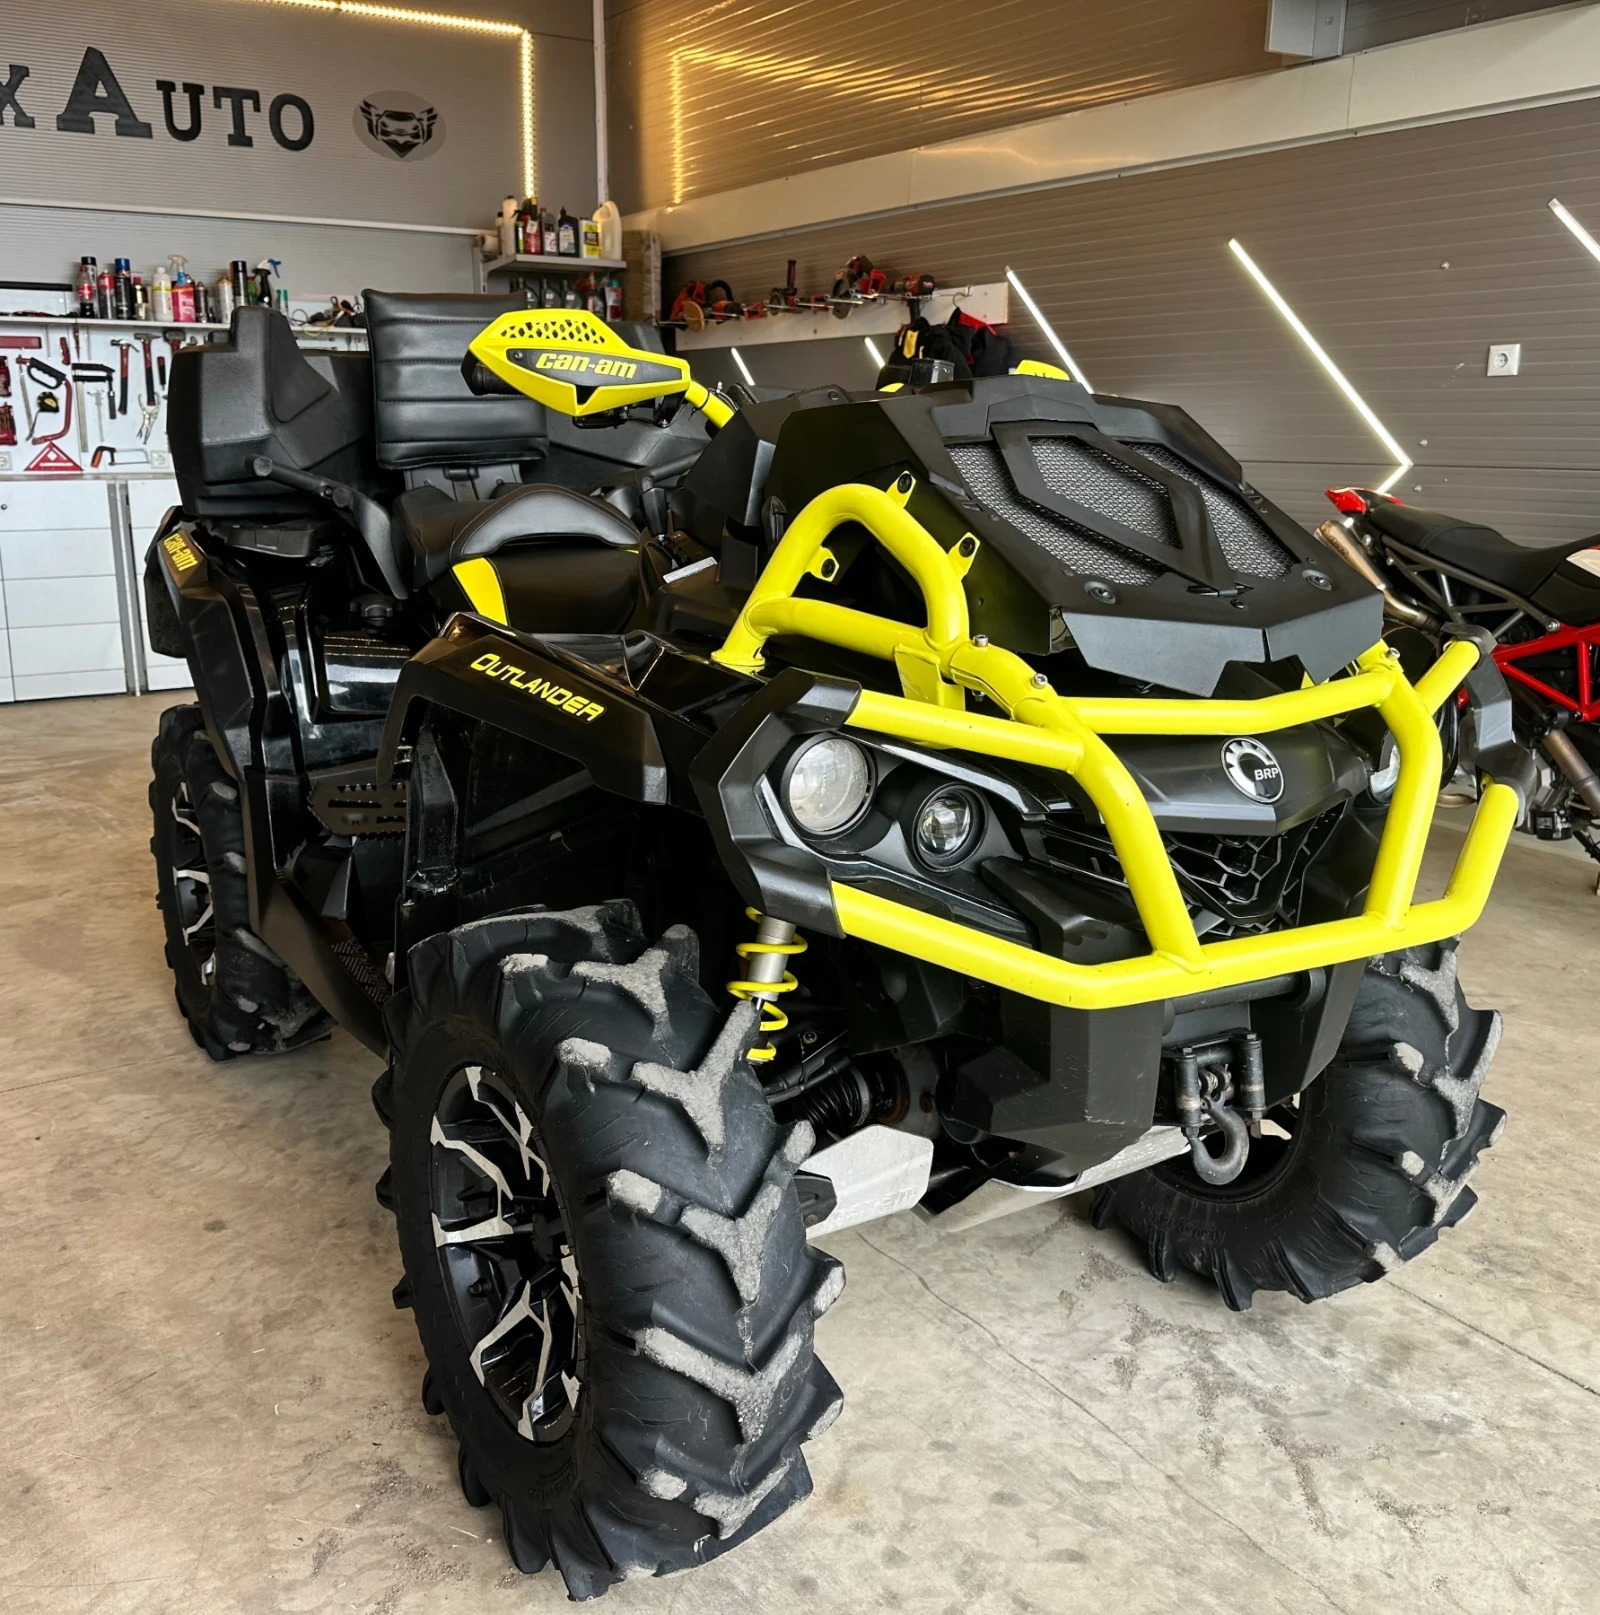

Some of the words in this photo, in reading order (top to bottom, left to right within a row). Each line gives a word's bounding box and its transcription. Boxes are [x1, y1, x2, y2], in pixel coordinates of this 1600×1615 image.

[56, 46, 315, 152] AUTO
[535, 352, 637, 379] can-am
[163, 533, 198, 571] can-am
[470, 653, 605, 721] OUTLANDER
[1254, 767, 1279, 781] BRP
